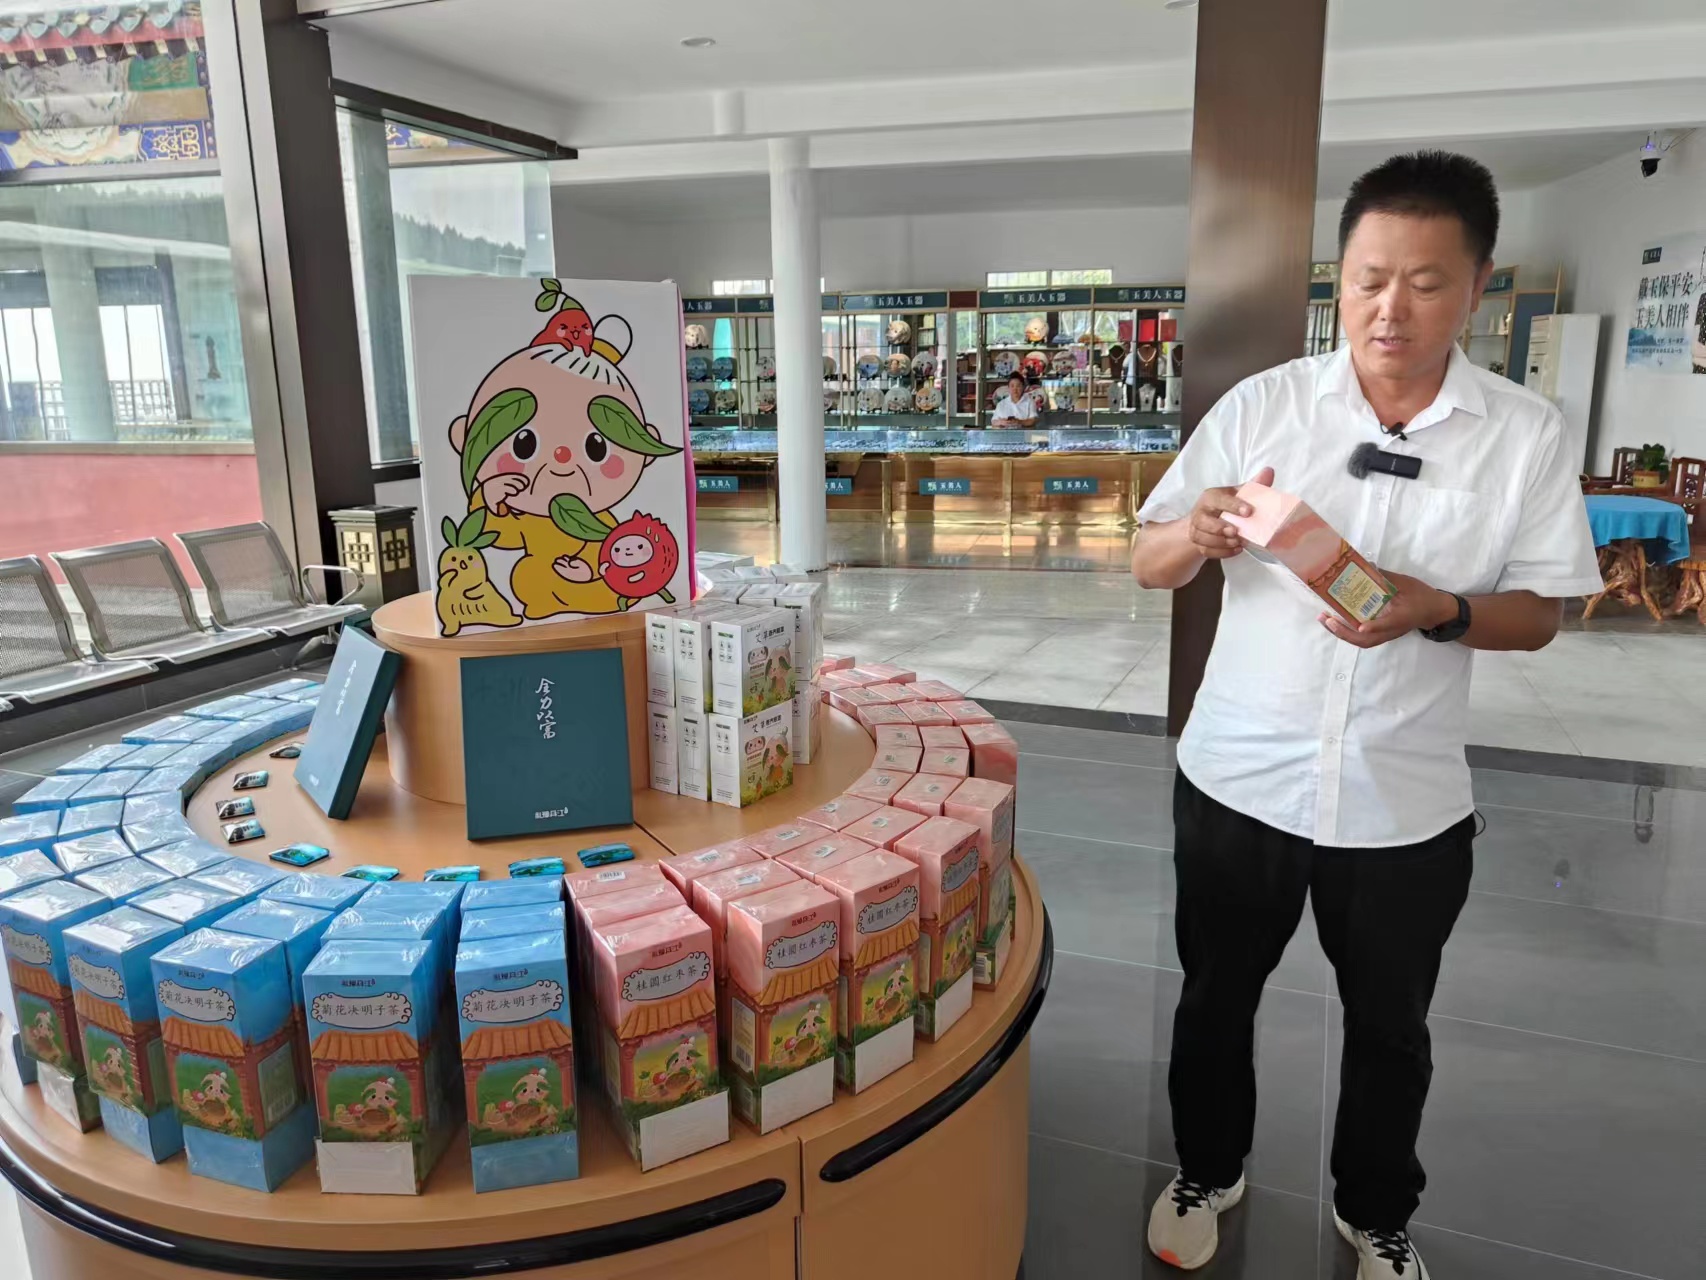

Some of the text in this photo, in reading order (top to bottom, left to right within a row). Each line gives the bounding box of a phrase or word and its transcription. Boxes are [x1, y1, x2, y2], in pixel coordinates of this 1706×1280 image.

[878, 295, 924, 306] 玉美人玉器
[1018, 292, 1067, 303] 玉美人玉器
[1133, 289, 1183, 300] 玉美人玉器
[684, 301, 713, 311] 人玉器
[776, 934, 828, 960] 桂圆红枣茶
[635, 964, 698, 992] 桂圆红枣茶
[165, 989, 226, 1011] 菊花决明子茶
[471, 992, 552, 1013] 菊花决明子茶
[321, 1003, 400, 1017] 菊花决明子茶
